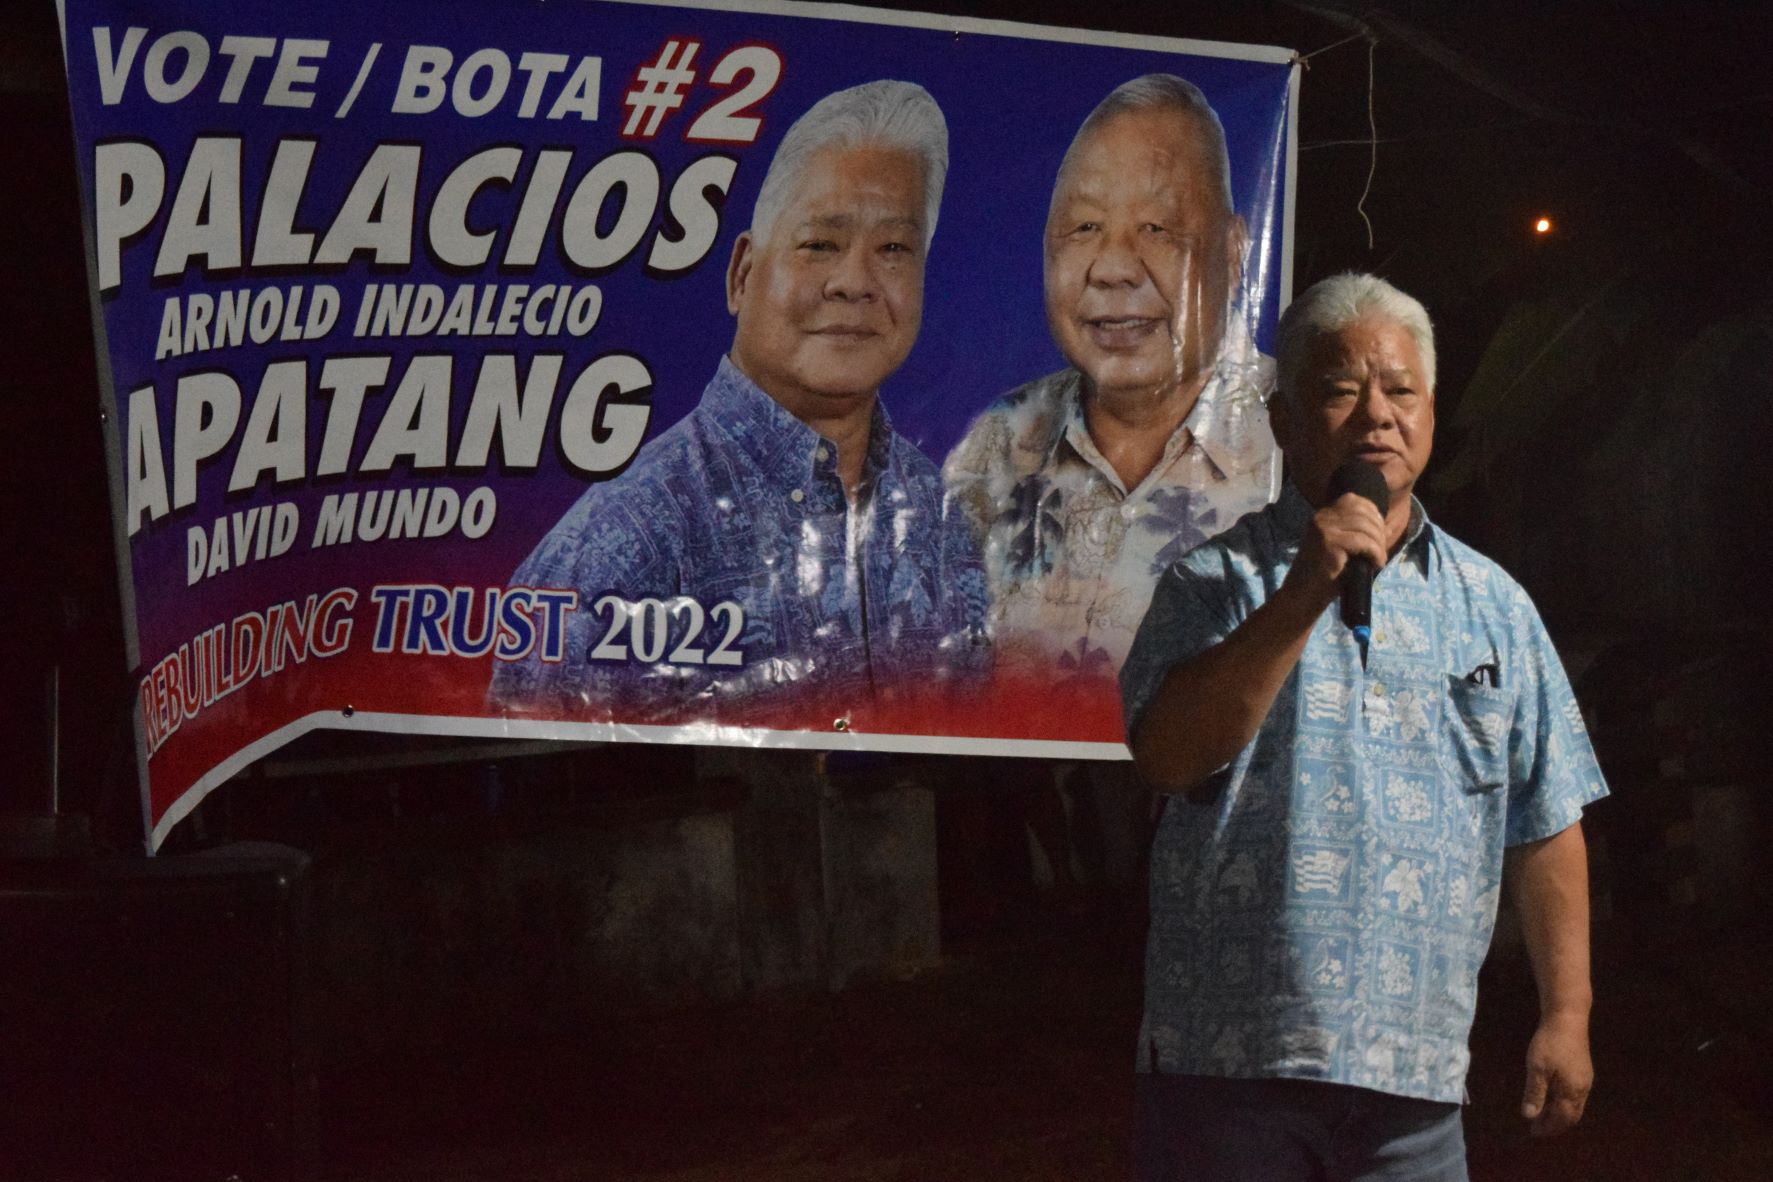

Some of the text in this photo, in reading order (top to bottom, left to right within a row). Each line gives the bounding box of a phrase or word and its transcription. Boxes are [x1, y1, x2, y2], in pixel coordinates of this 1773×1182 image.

[92, 25, 785, 145] VOTE / BOTA #2
[95, 137, 738, 291] PALACIOS
[155, 284, 602, 360] ARNOLD INDALECIO
[127, 354, 653, 537] APATANG
[187, 486, 497, 586] DAVID MUNDO
[141, 584, 745, 761] REBUILDING TRUST 2022
